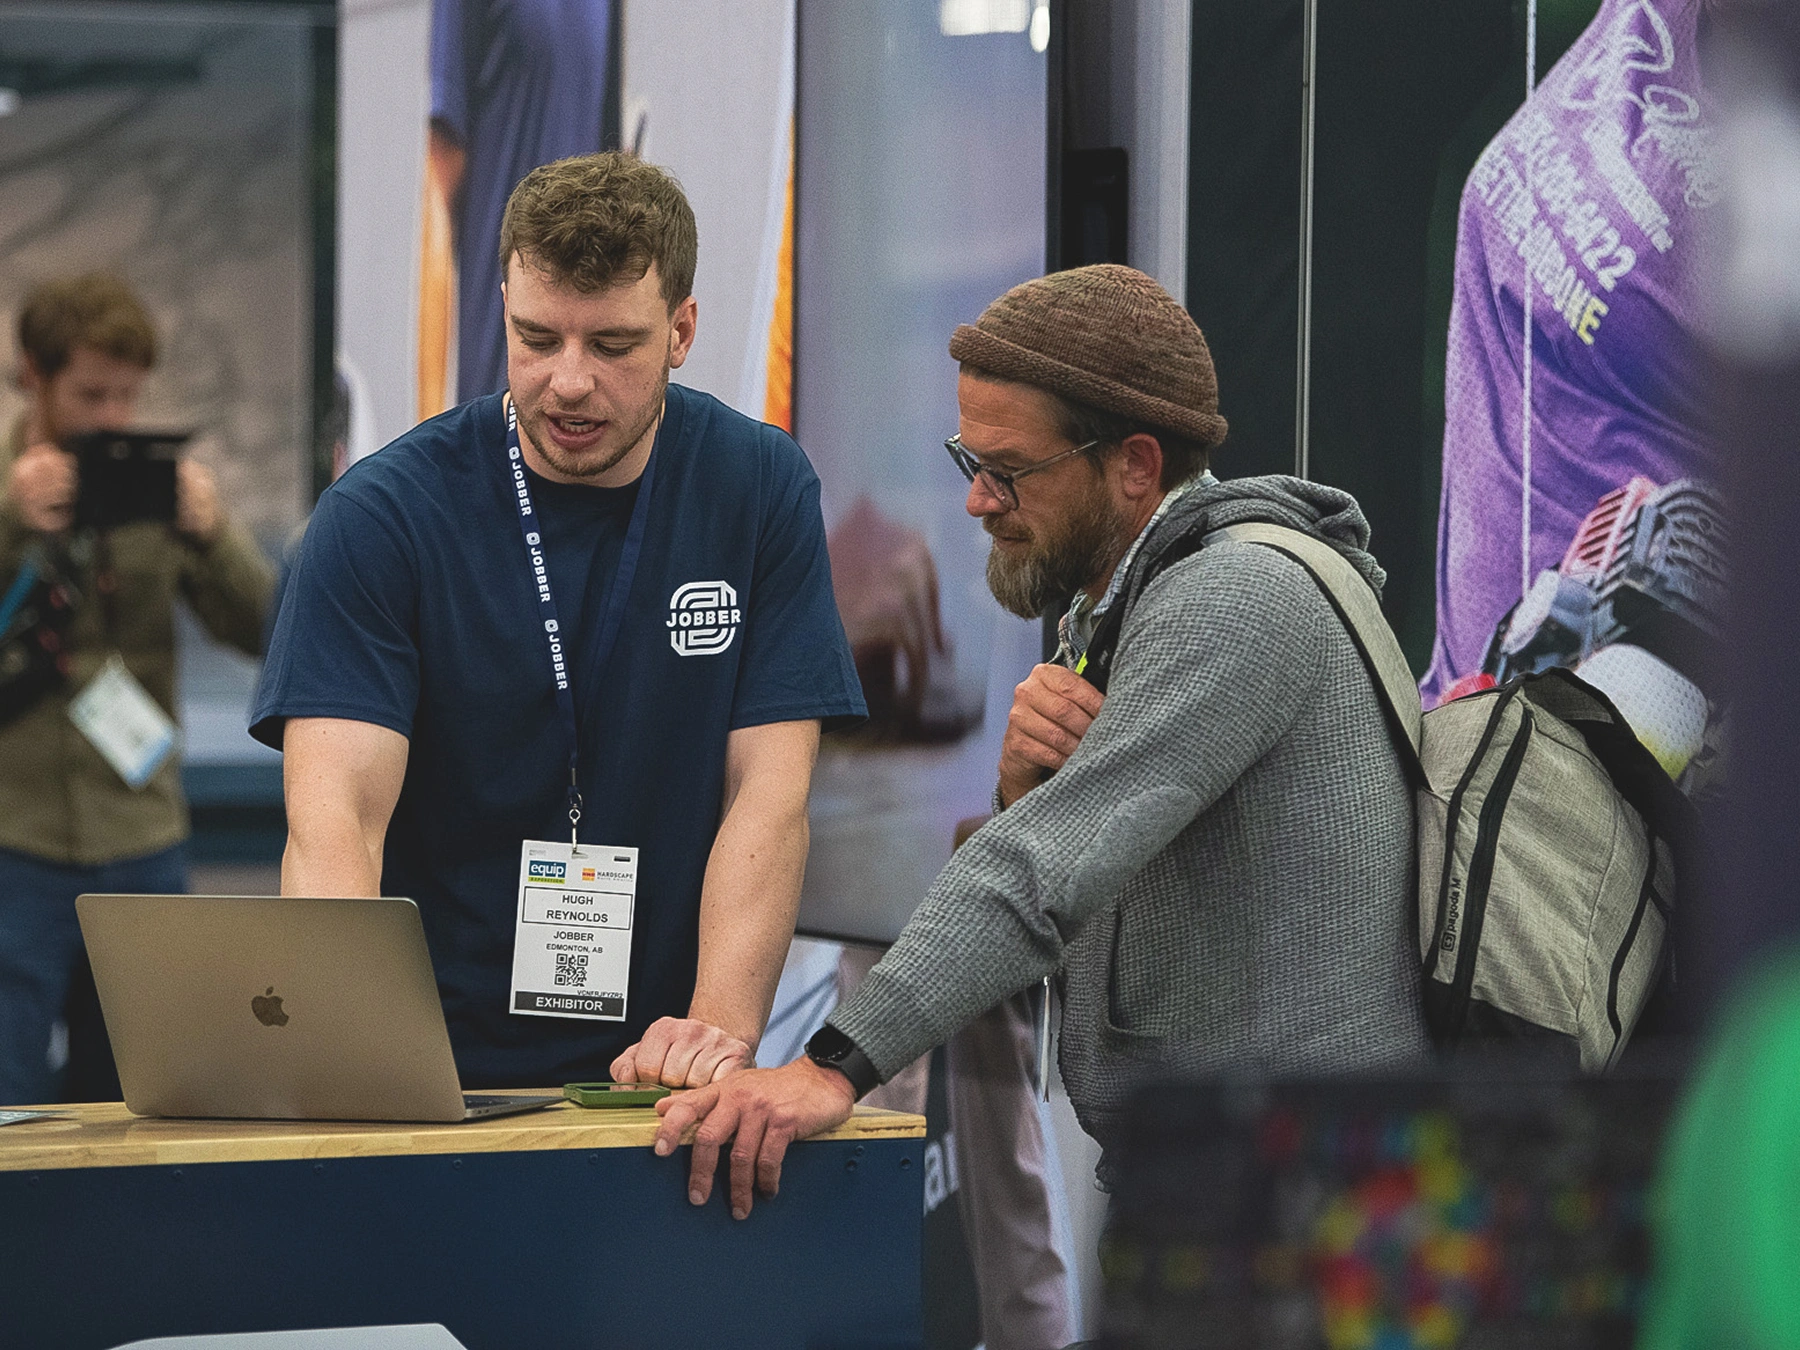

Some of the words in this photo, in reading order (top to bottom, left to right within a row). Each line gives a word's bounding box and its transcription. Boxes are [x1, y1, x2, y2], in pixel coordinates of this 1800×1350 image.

[512, 462, 532, 516] JOBBER
[531, 547, 550, 602] JOBBER
[666, 609, 741, 627] JOBBER
[549, 634, 568, 690] JOBBER
[530, 863, 564, 878] equip
[597, 871, 633, 879] HARDSCAPE
[562, 895, 593, 905] HUGH
[546, 910, 608, 923] REYNOLDS
[553, 931, 594, 941] JOBBER
[546, 943, 590, 953] EDMONTON,
[536, 997, 603, 1011] EXHIBITOR
